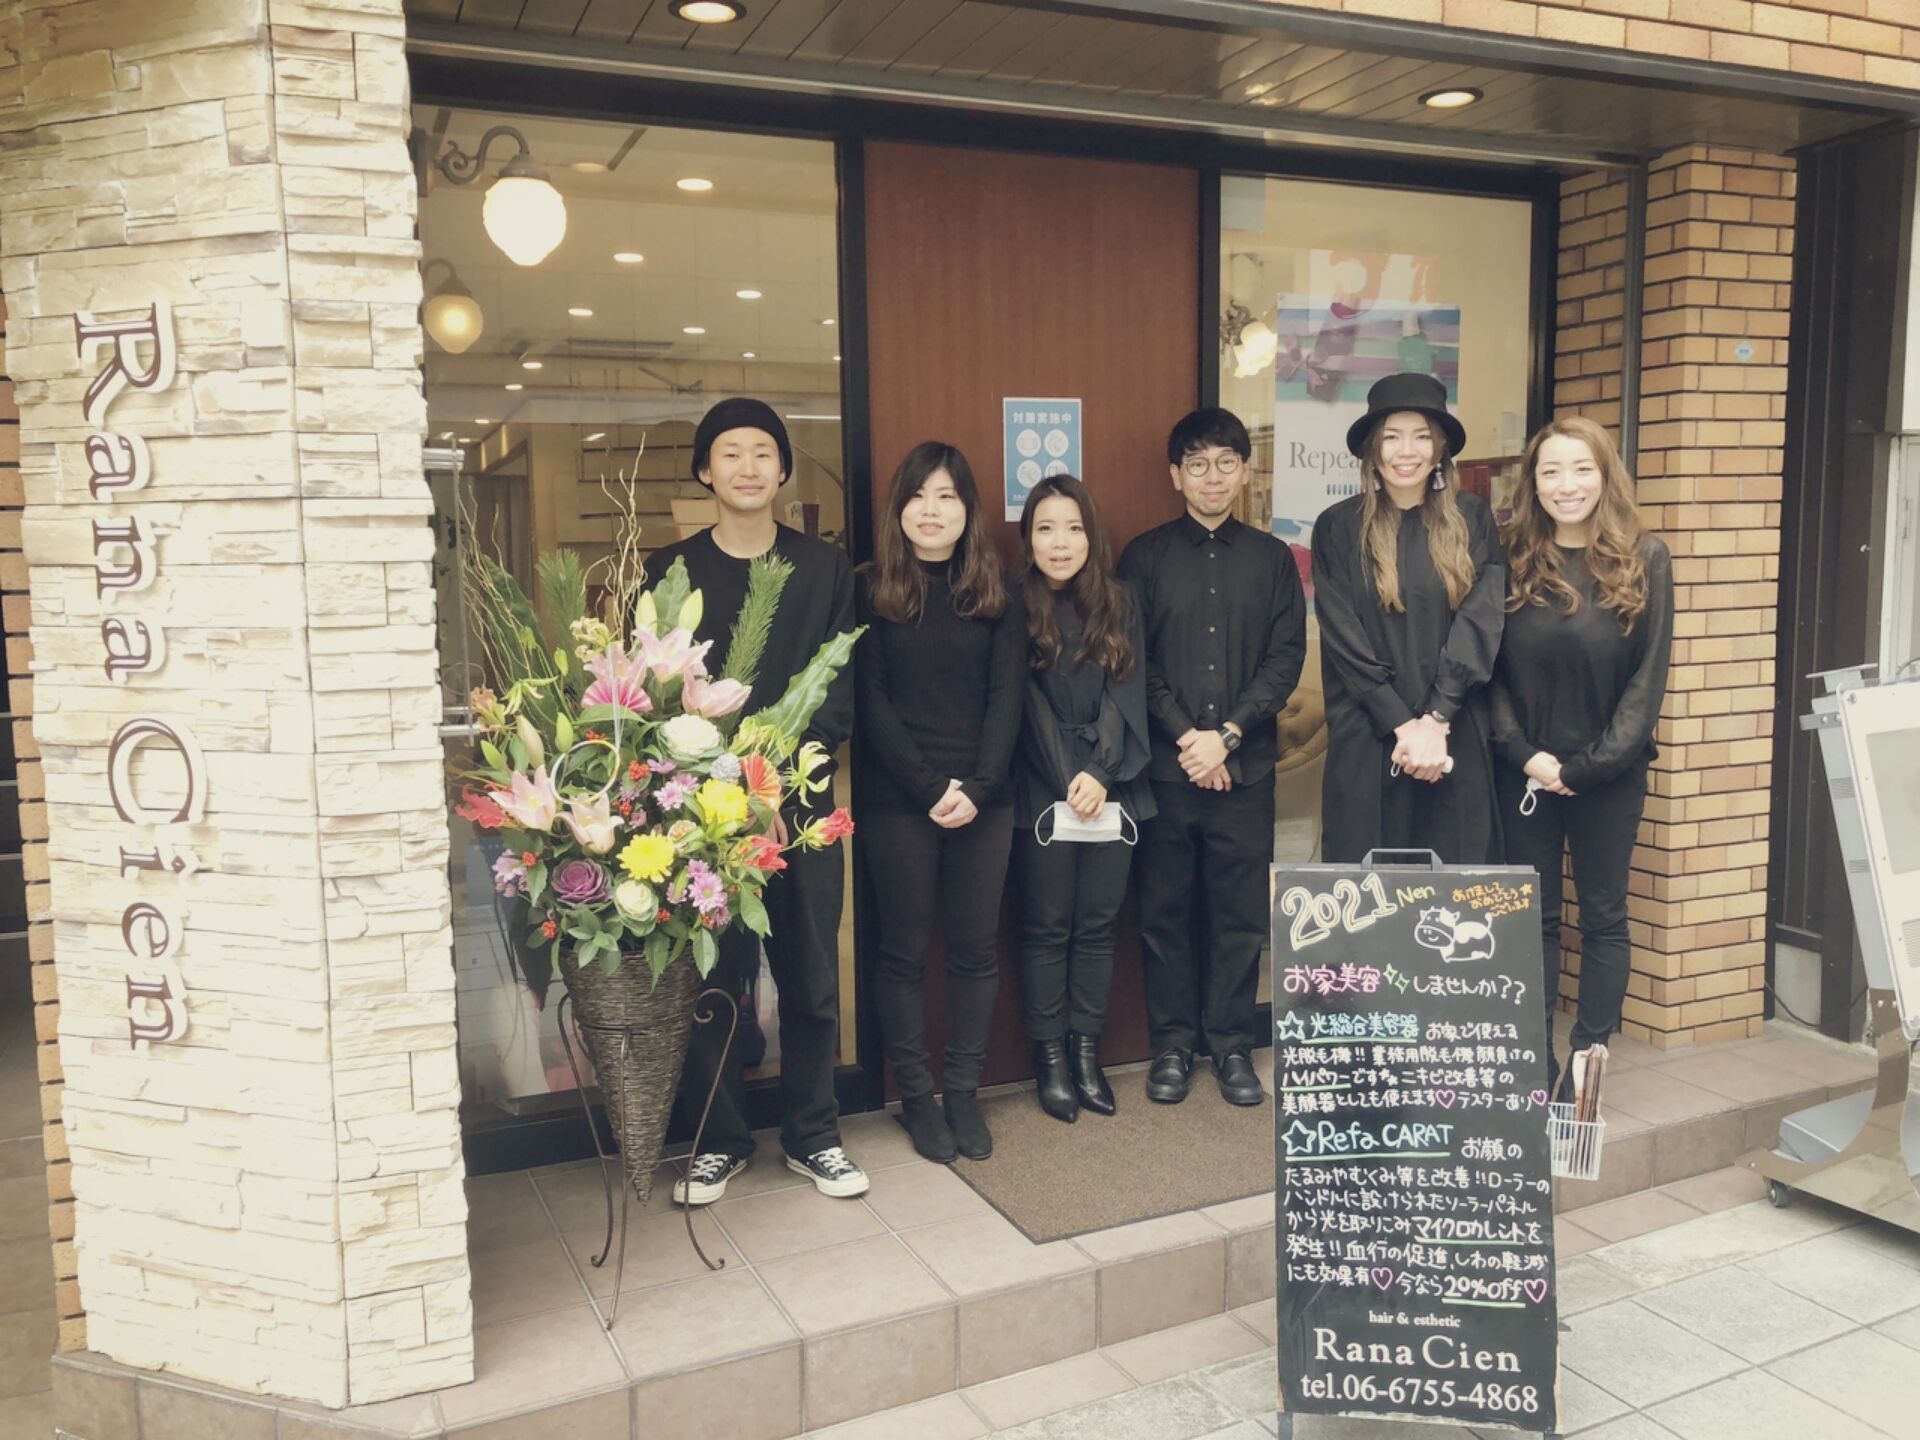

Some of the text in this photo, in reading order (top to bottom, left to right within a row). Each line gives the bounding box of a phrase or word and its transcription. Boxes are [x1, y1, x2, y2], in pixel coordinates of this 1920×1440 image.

[74, 300, 200, 1052] Rana Cien
[1281, 872, 1436, 951] 2021 Nen
[1283, 962, 1526, 1005] お家美容 しませんか??
[1310, 1010, 1519, 1042] 光総合美容器 お家で使える
[1457, 1091, 1532, 1112] テスターあり
[1381, 1122, 1454, 1149] CARAT
[1461, 1136, 1523, 1161] お顔の
[1368, 1310, 1461, 1328] hair & esthetic
[1300, 1372, 1539, 1414] tel.06-6755-4868
